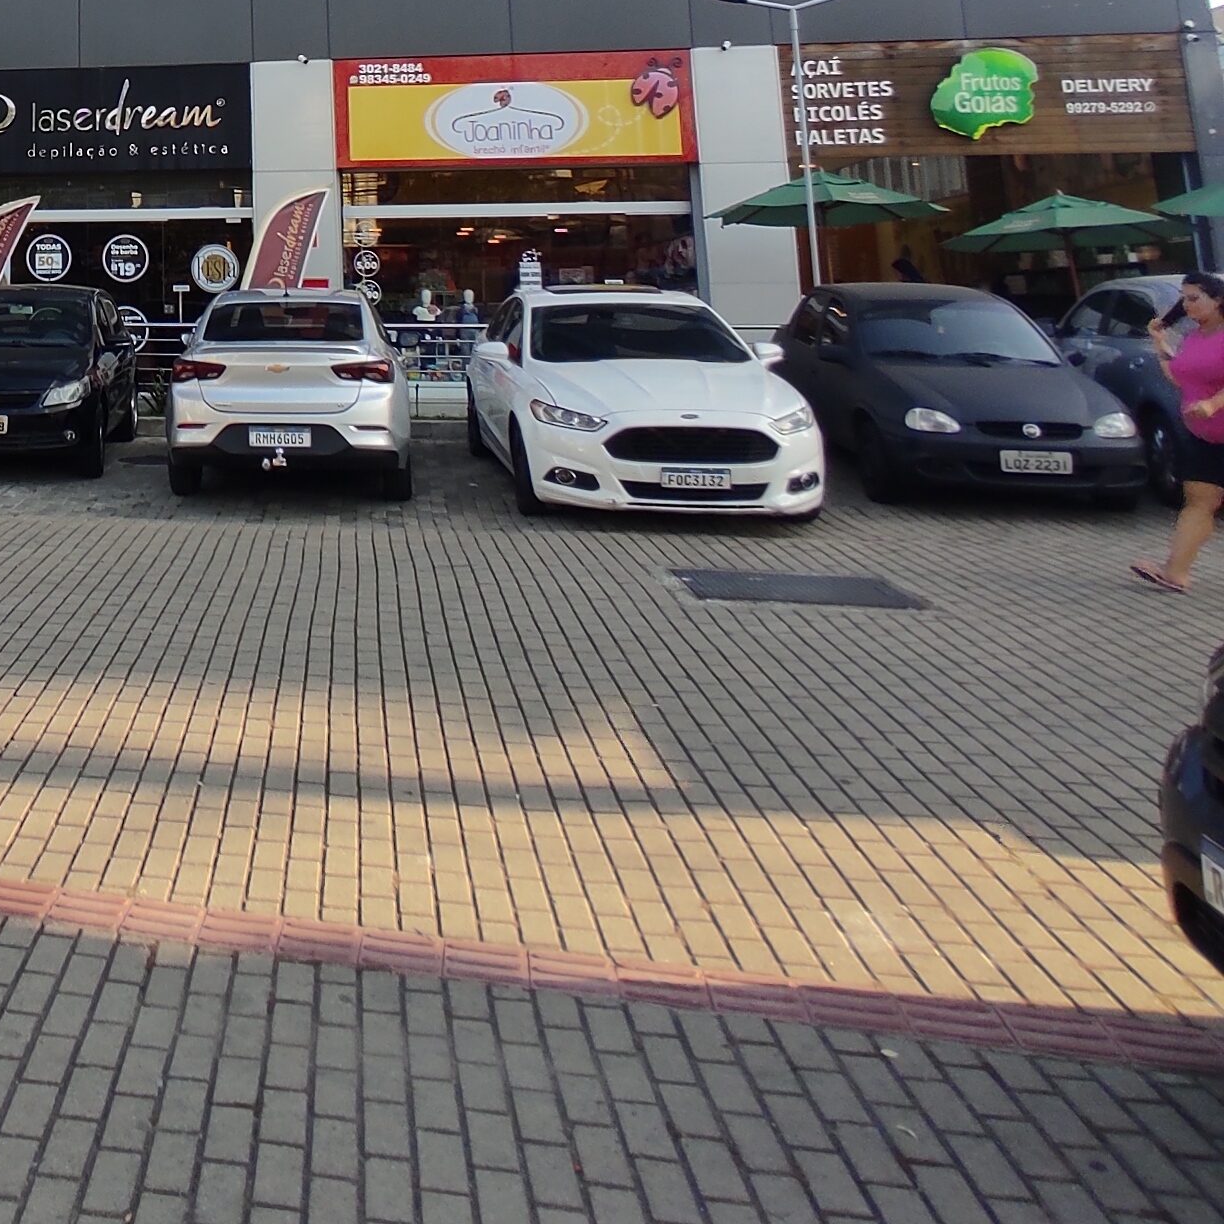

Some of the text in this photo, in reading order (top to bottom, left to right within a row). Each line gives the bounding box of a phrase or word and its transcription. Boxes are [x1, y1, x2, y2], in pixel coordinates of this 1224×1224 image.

[359, 63, 423, 74] 3021-8484
[359, 74, 432, 84] 98345-0249
[961, 73, 1021, 91] Frutos
[1062, 78, 1153, 93] DELIVERY
[791, 81, 894, 100] SORVETES
[31, 78, 222, 136] laserdream
[954, 92, 1017, 113] Goiás
[1066, 101, 1142, 114] 99279-5292
[464, 119, 553, 142] Joaninha
[27, 141, 229, 160] depilação & estética
[36, 243, 61, 251] TODAS
[255, 433, 304, 445] RMH6G05
